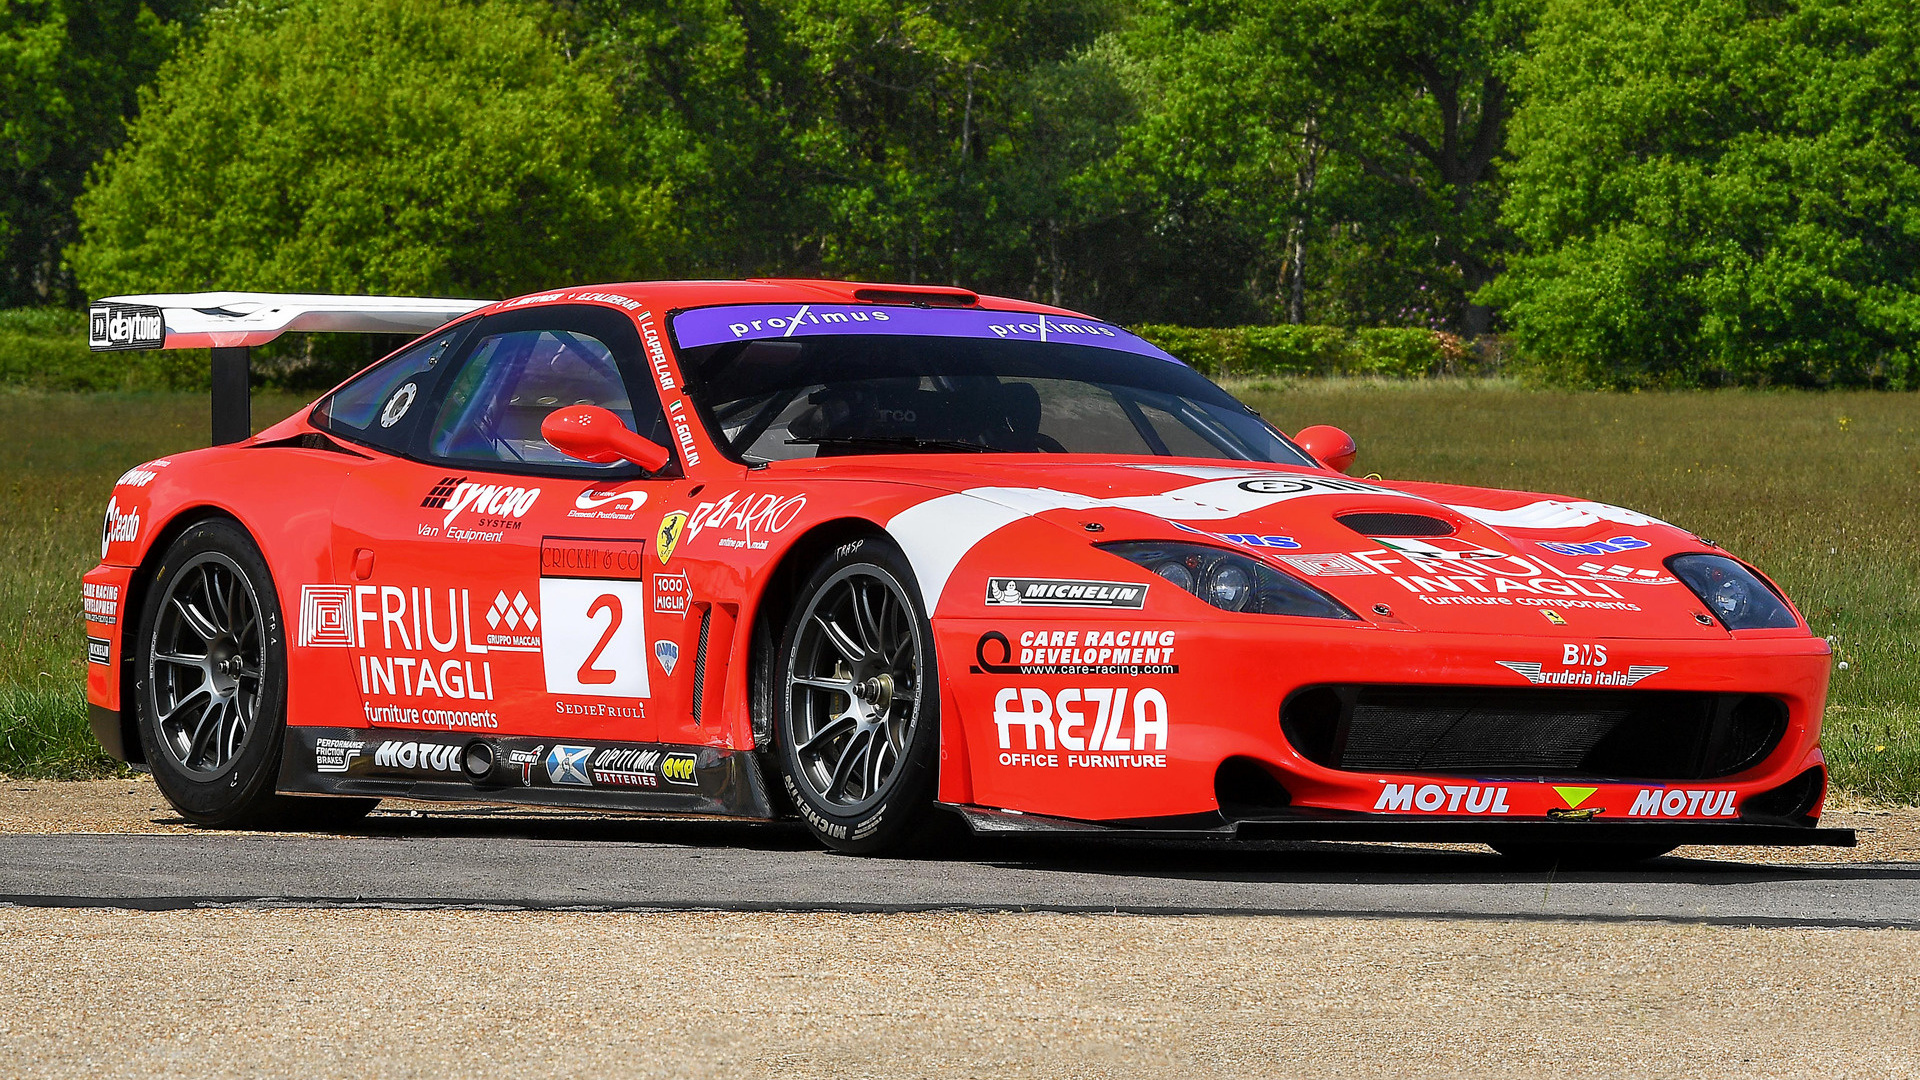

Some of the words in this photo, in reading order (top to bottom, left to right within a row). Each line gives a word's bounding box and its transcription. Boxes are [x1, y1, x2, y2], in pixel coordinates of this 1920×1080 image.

[109, 311, 161, 344] daytona
[728, 304, 891, 338] proximus
[987, 313, 1116, 342] proximus
[641, 321, 676, 391] L.CAPPELLARI
[672, 414, 701, 468] F.GOLLIN
[442, 482, 541, 530] SYNCRO
[110, 505, 140, 543] Ceado
[417, 523, 439, 537] Van
[446, 526, 503, 543] Equipment
[478, 518, 522, 530] SYSTEM
[541, 547, 598, 569] CRICKET
[602, 551, 614, 570] &
[617, 550, 640, 571] CO
[1350, 549, 1597, 581] FRIUL
[95, 584, 119, 600] RACING
[657, 578, 683, 592] 1000
[1024, 583, 1140, 601] MICHELIN
[1390, 575, 1625, 600] INTAGLI
[656, 595, 685, 610] MIGLIA
[1418, 594, 1513, 607] furniture
[1514, 596, 1642, 612] components
[355, 584, 489, 655] FRIUL
[486, 633, 512, 646] GRUPPO
[512, 635, 541, 647] MACCAN
[576, 593, 624, 685] 2
[1020, 630, 1079, 647] CARE
[1083, 630, 1176, 647] RACING
[1019, 648, 1175, 665] DEVELOPMENT
[1562, 643, 1608, 667] BMS
[359, 655, 494, 701] INTAGLI
[1019, 663, 1175, 677] www.care-racing.com
[1538, 669, 1593, 686] scuderia
[1594, 670, 1629, 687] italia
[363, 701, 420, 725] furniture
[421, 707, 499, 730] components
[315, 747, 345, 757] FRICTION
[316, 738, 365, 749] PERFORMANCE
[316, 755, 344, 765] BRAKES
[374, 740, 463, 772] MOTUL
[511, 752, 537, 763] KONI
[594, 748, 661, 772] OPTIMA
[998, 752, 1059, 768] OFFICE
[1067, 754, 1168, 768] FURNITURE
[595, 773, 658, 787] BATTERIES
[662, 757, 695, 780] OMP
[784, 774, 848, 840] MICHELIN
[1373, 783, 1511, 815] MOTUL
[1627, 789, 1738, 817] MOTUL
